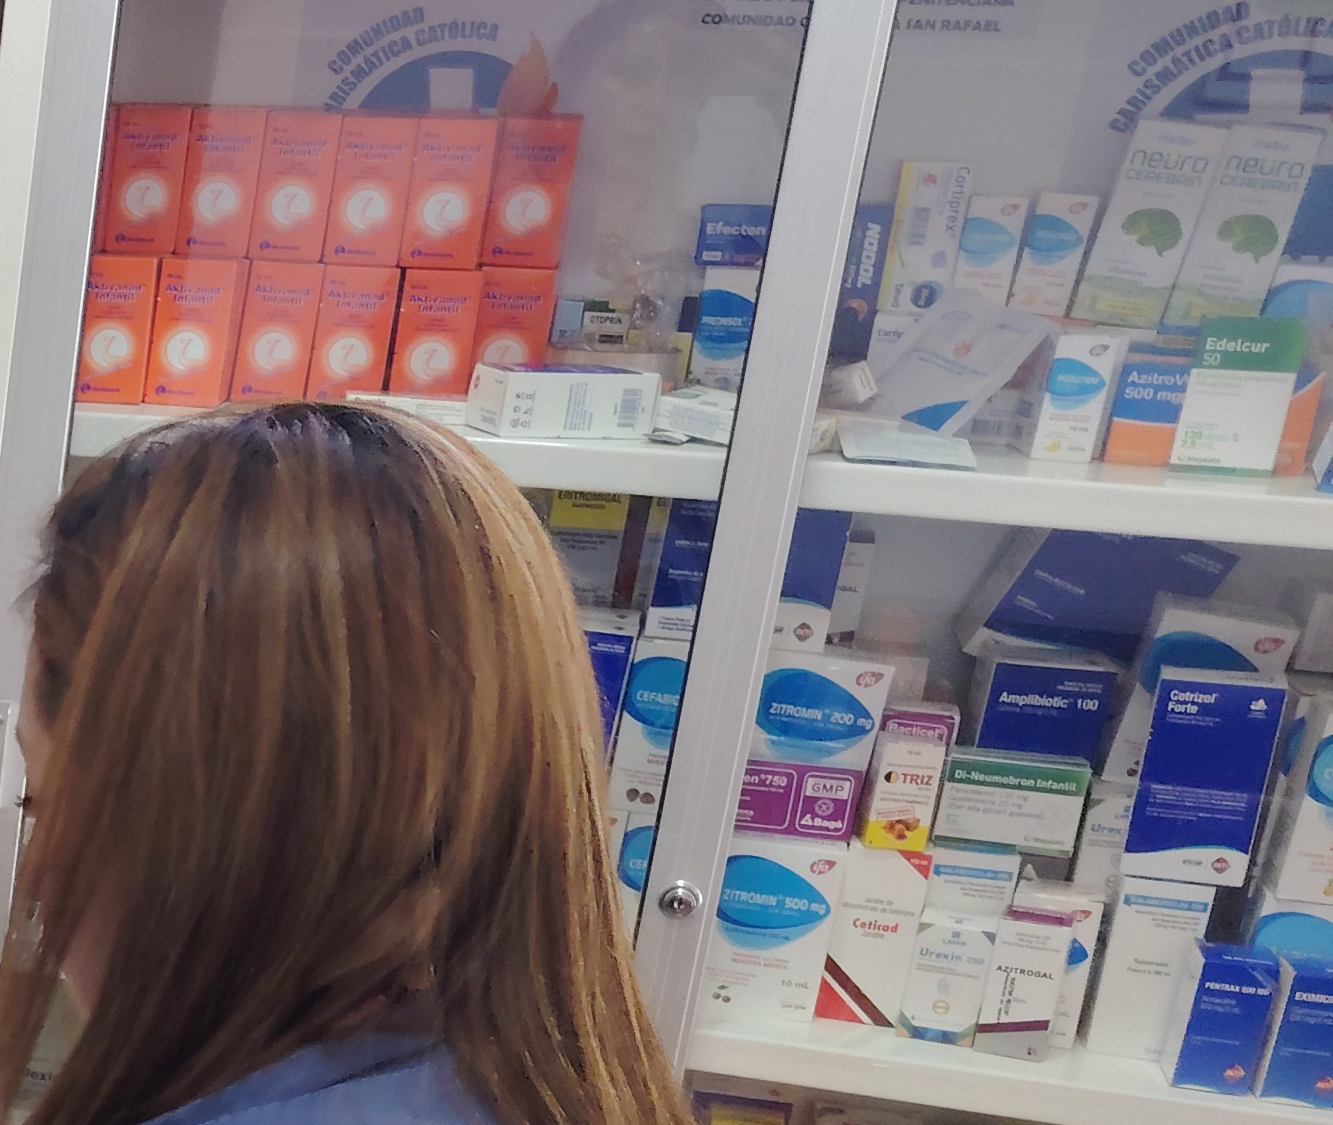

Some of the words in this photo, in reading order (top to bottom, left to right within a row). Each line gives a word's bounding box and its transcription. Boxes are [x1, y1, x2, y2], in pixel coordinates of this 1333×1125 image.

[702, 14, 796, 27] COMUNIDAD
[906, 19, 937, 31] SAN
[939, 19, 1002, 32] RAFAEL
[327, 6, 424, 76] COMUNIDAD
[414, 18, 499, 47] CATÓLICA
[1127, 1, 1251, 77] COMUNIDAD
[1108, 33, 1234, 134] CARISMÁTICA
[945, 166, 970, 233] Cortiprex
[1204, 337, 1271, 354] Edelcur
[1202, 353, 1221, 367] 50
[1124, 387, 1154, 400] 500
[1076, 698, 1100, 711] 100
[769, 702, 822, 720] ZITROMIN
[830, 712, 854, 725] 200
[856, 716, 874, 730] mg
[766, 774, 788, 787] 750
[811, 780, 846, 795] GMP
[900, 772, 933, 787] TRIZ
[954, 769, 1036, 787] Di-Neumobron
[1036, 778, 1078, 792] Infantil
[722, 888, 777, 907] ZITROMIN
[784, 896, 809, 910] 500
[809, 901, 827, 915] mg
[852, 917, 900, 934] Ceticad
[919, 947, 963, 962] Urexin
